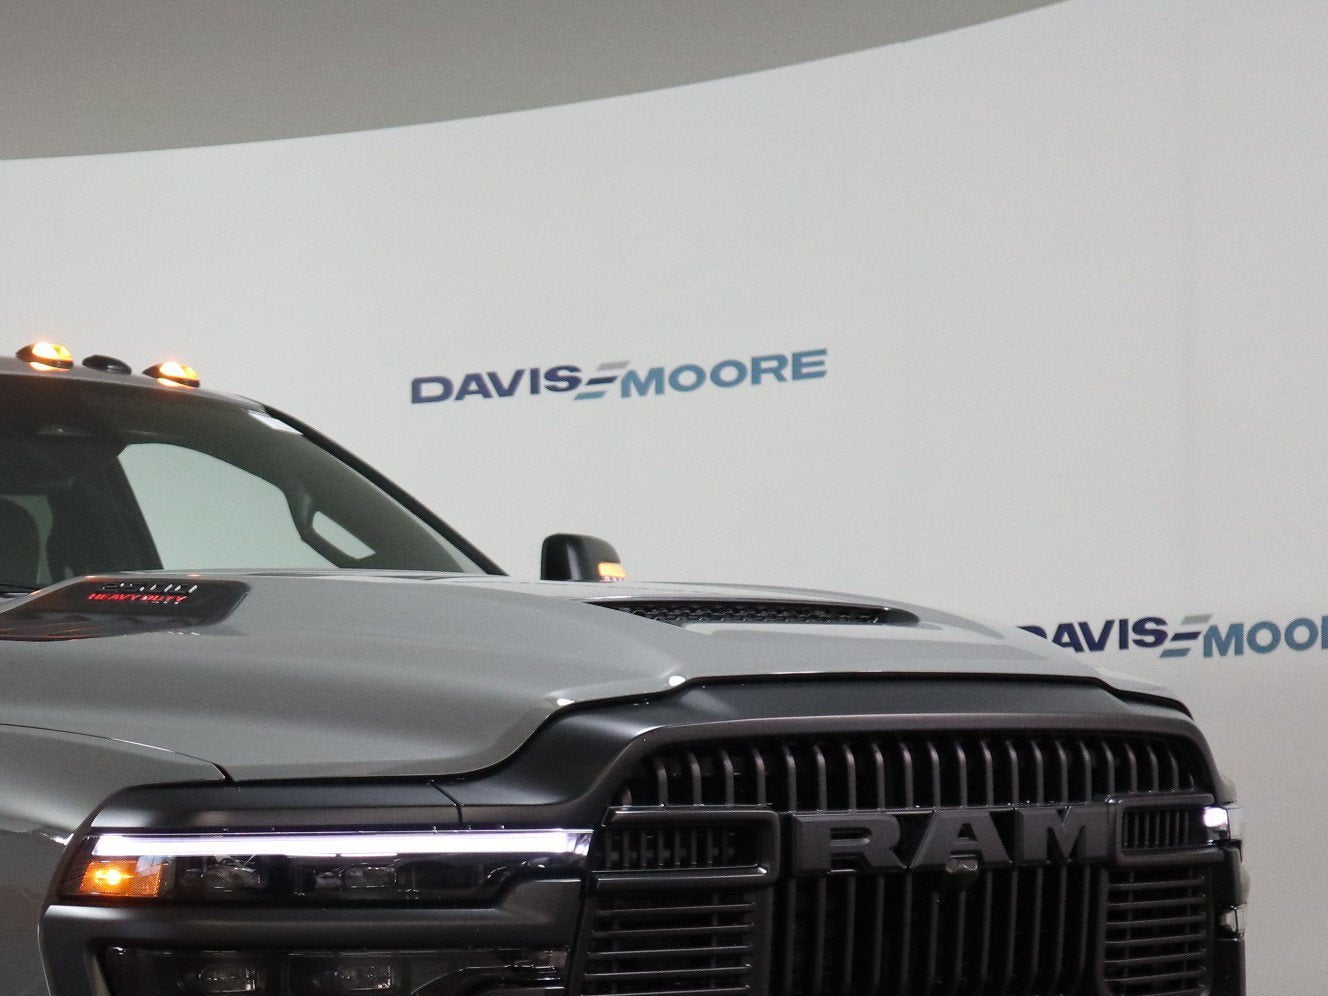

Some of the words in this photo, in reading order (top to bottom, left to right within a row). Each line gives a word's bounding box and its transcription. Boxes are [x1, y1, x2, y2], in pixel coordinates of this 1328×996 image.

[411, 366, 582, 403] DAVIS
[621, 349, 827, 397] MOORE
[1204, 615, 1328, 657] MOO
[793, 804, 1110, 871] RAM
